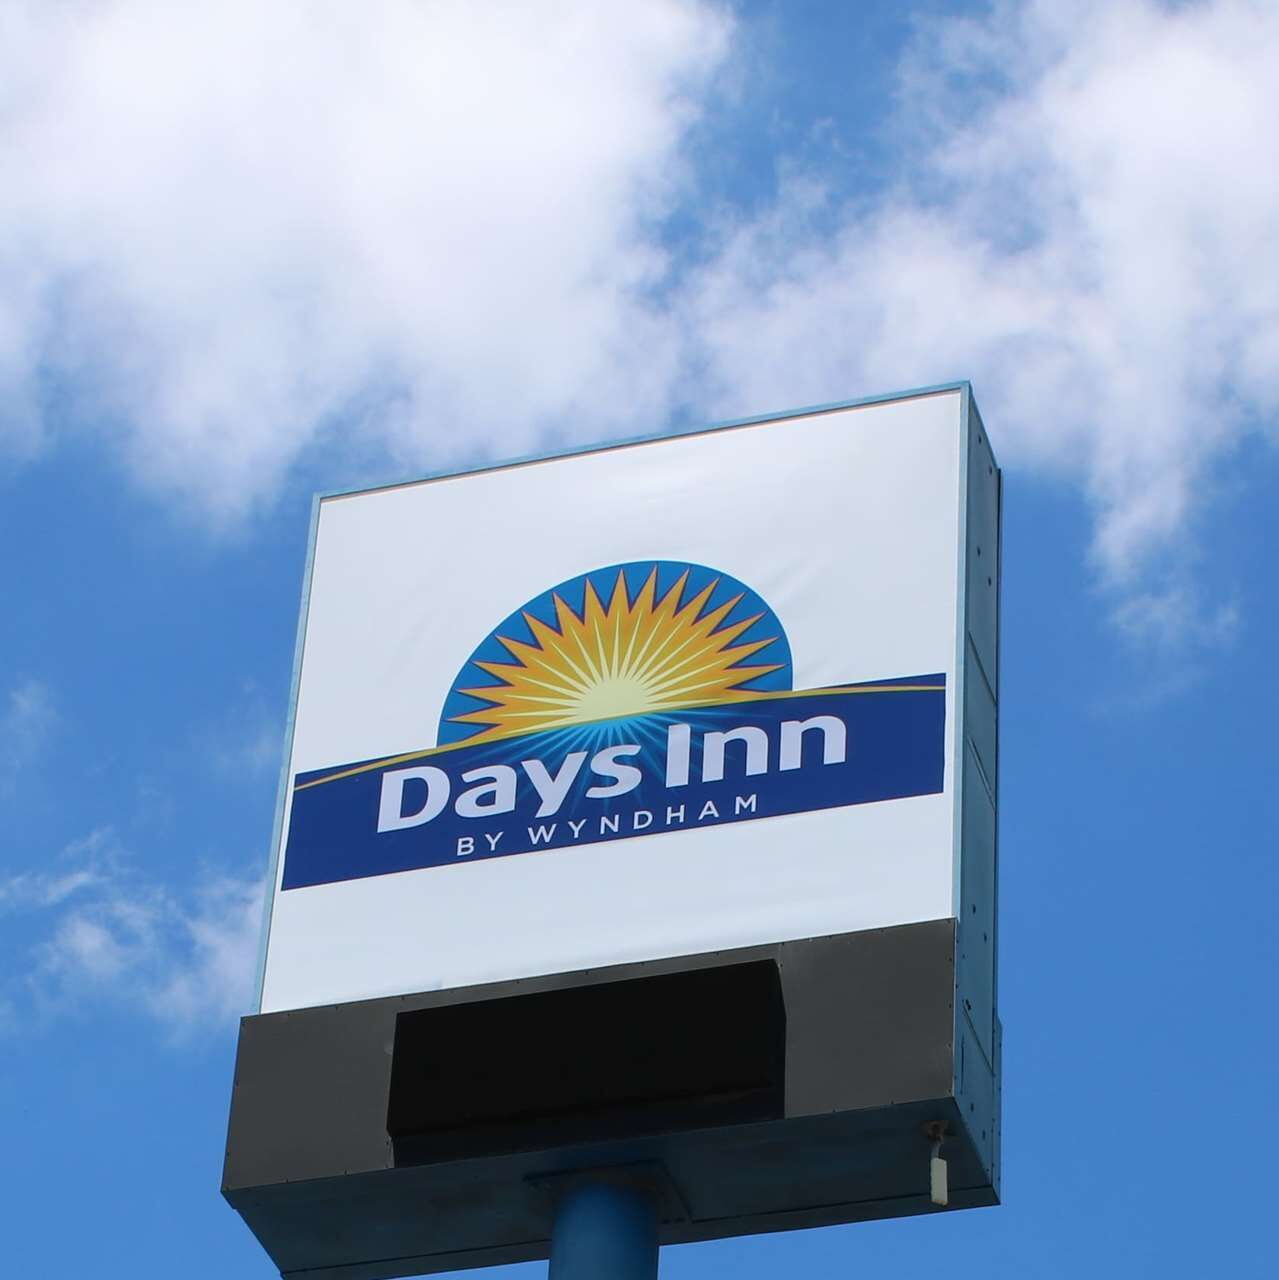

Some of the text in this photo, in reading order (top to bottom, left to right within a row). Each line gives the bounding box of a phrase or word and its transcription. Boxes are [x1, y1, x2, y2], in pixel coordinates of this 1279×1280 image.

[376, 714, 847, 834] Days Inn
[455, 793, 758, 857] BY WYNDHAM
